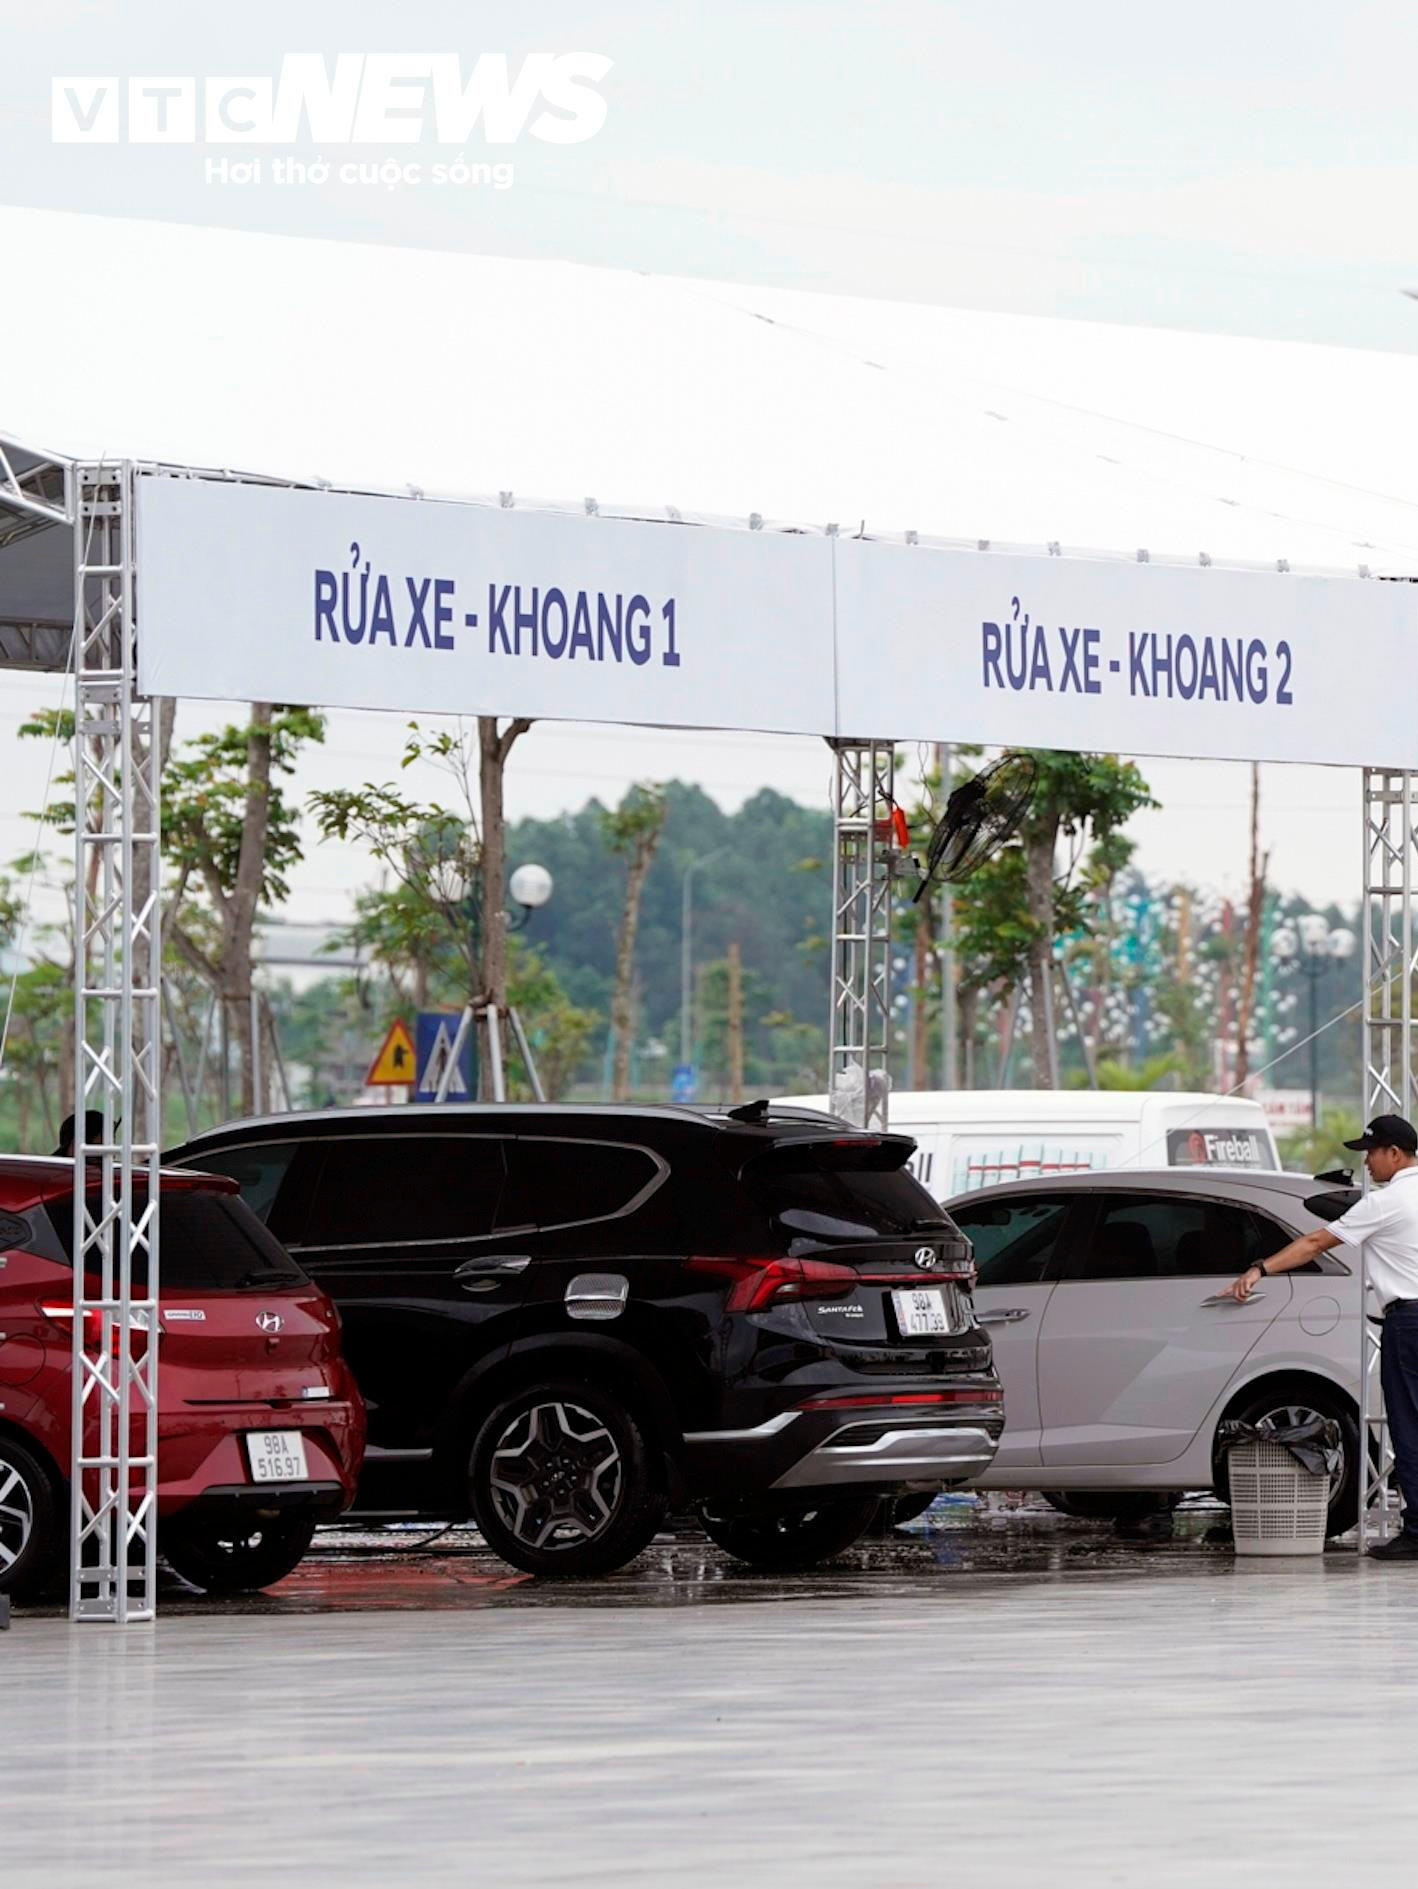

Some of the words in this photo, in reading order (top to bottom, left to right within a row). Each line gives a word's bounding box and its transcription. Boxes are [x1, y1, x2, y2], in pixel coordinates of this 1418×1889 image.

[314, 541, 397, 647] RỬA
[404, 576, 456, 650] XE
[488, 583, 652, 667] KHOANG
[661, 598, 681, 668] 1
[981, 595, 1053, 692] RỬA
[1059, 626, 1102, 694] XE
[1128, 631, 1269, 705] KHOANG
[1275, 640, 1294, 706] 2
[1204, 1134, 1260, 1162] Fireball
[264, 1434, 289, 1455] 98A
[257, 1457, 300, 1478] 516.97
